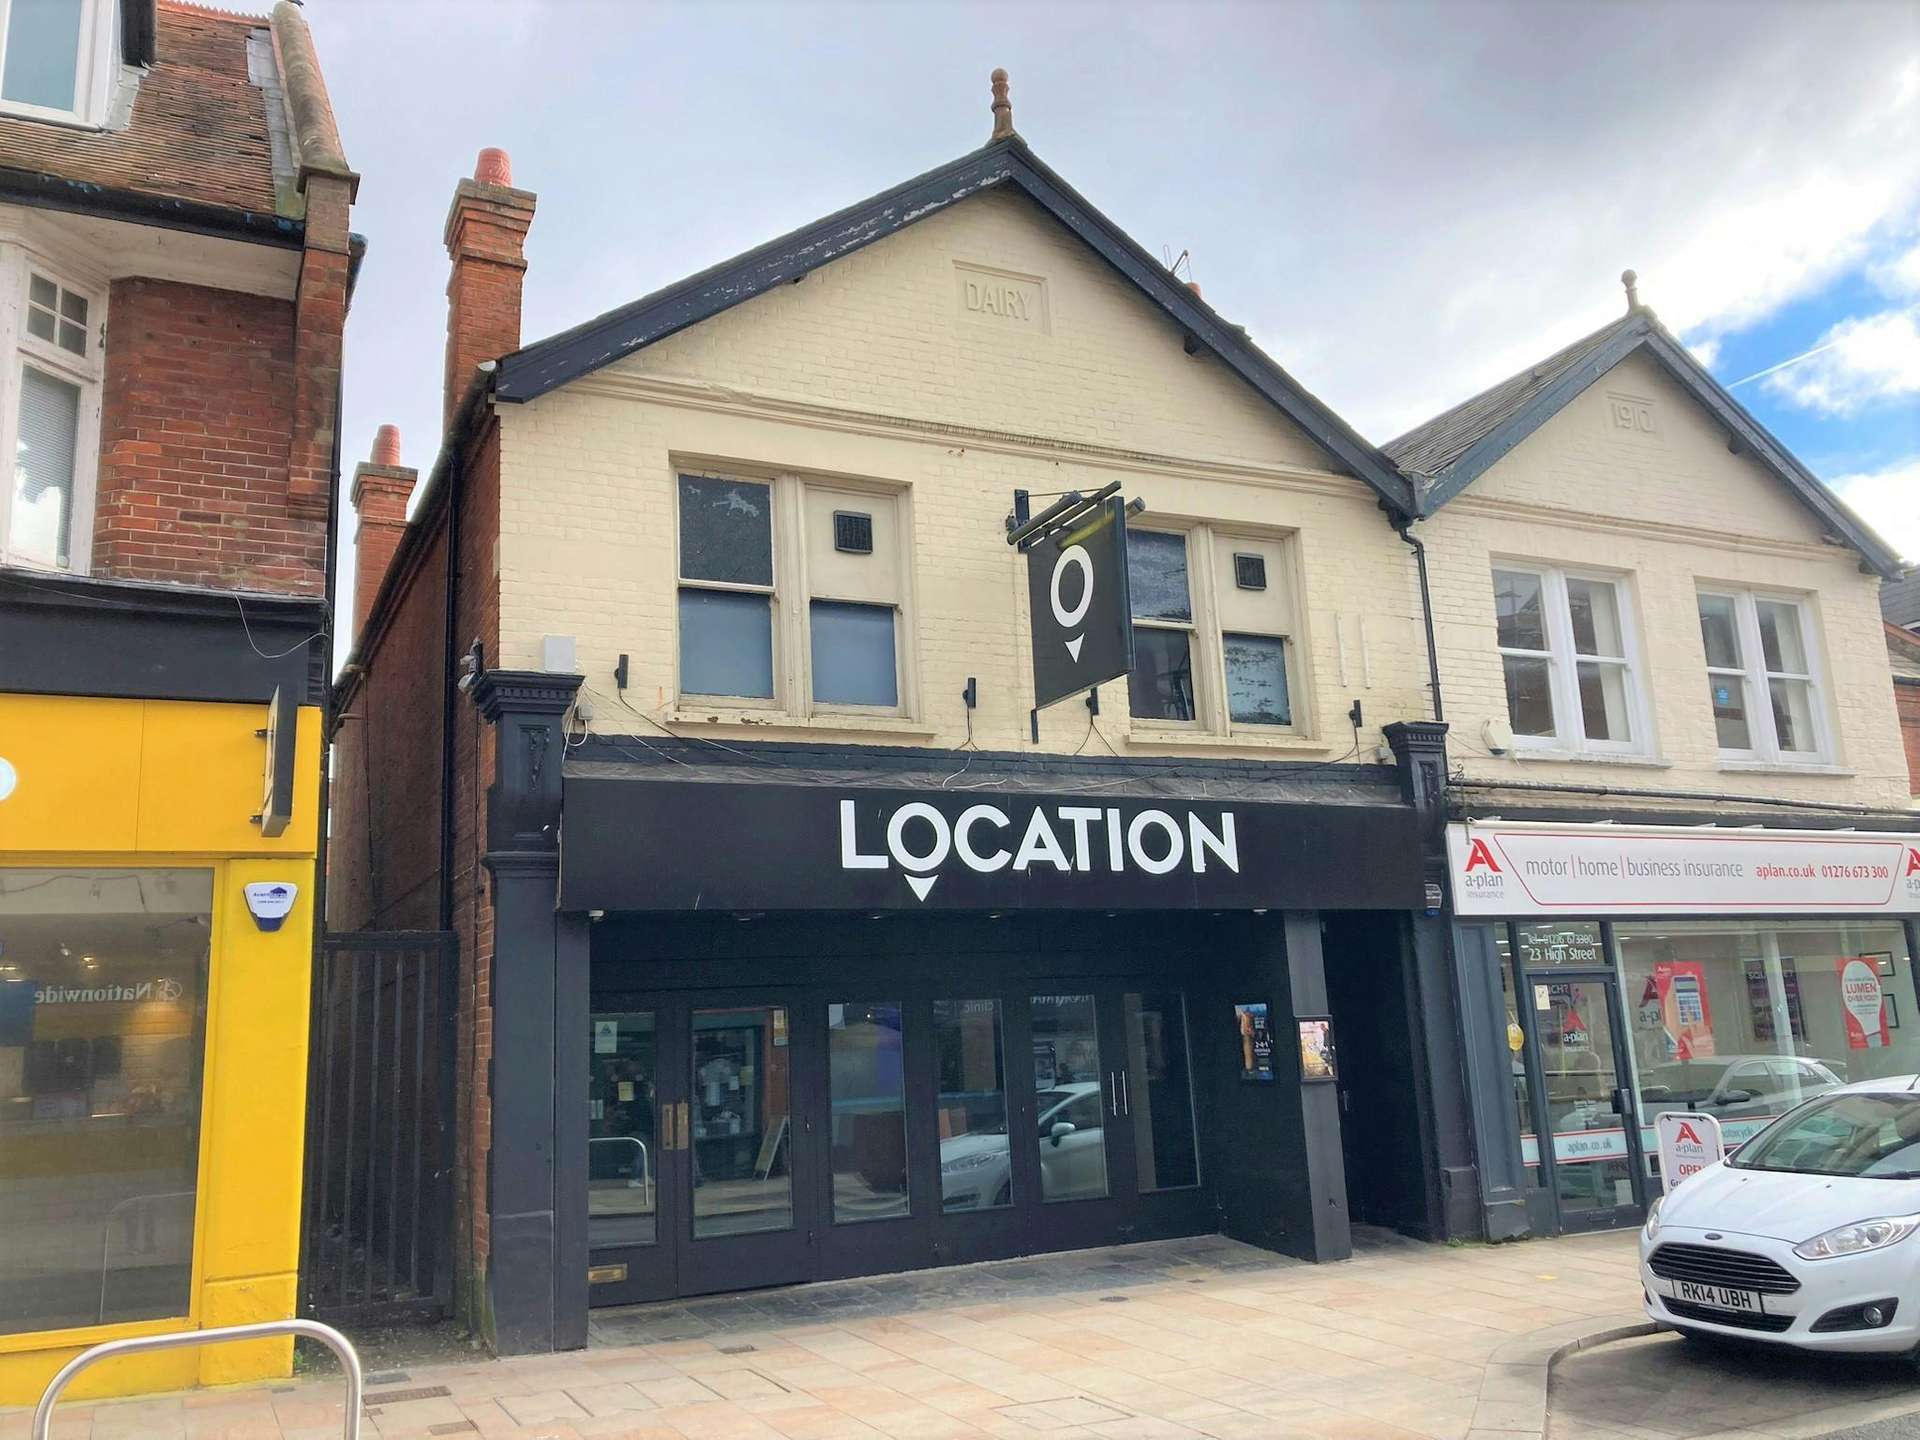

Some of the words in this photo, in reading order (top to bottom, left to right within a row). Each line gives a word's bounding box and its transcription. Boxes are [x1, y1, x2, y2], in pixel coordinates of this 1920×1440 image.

[964, 279, 1032, 321] DAIRY
[1611, 402, 1656, 433] 1910
[840, 799, 1240, 875] LOCATION
[1526, 856, 1568, 876] motor
[1578, 856, 1618, 876] home
[1627, 857, 1680, 877] business
[1684, 858, 1743, 877] insurance
[1755, 863, 1816, 880] aplan.co.uk
[1821, 865, 1850, 878] 01276
[1852, 865, 1869, 878] 673
[1872, 866, 1889, 879] 300
[1465, 872, 1503, 889] a-plan
[1529, 948, 1541, 960] 23
[1545, 948, 1566, 964] High
[1569, 947, 1597, 960] Street
[1846, 983, 1877, 994] LUMEN
[1640, 1009, 1661, 1024] a-pl
[1564, 1032, 1588, 1043] a-plan
[1568, 1138, 1612, 1154] aplan.co.uk
[1675, 1142, 1704, 1154] a-plan
[1681, 1282, 1716, 1303] RK14
[1719, 1288, 1752, 1309] UBH
